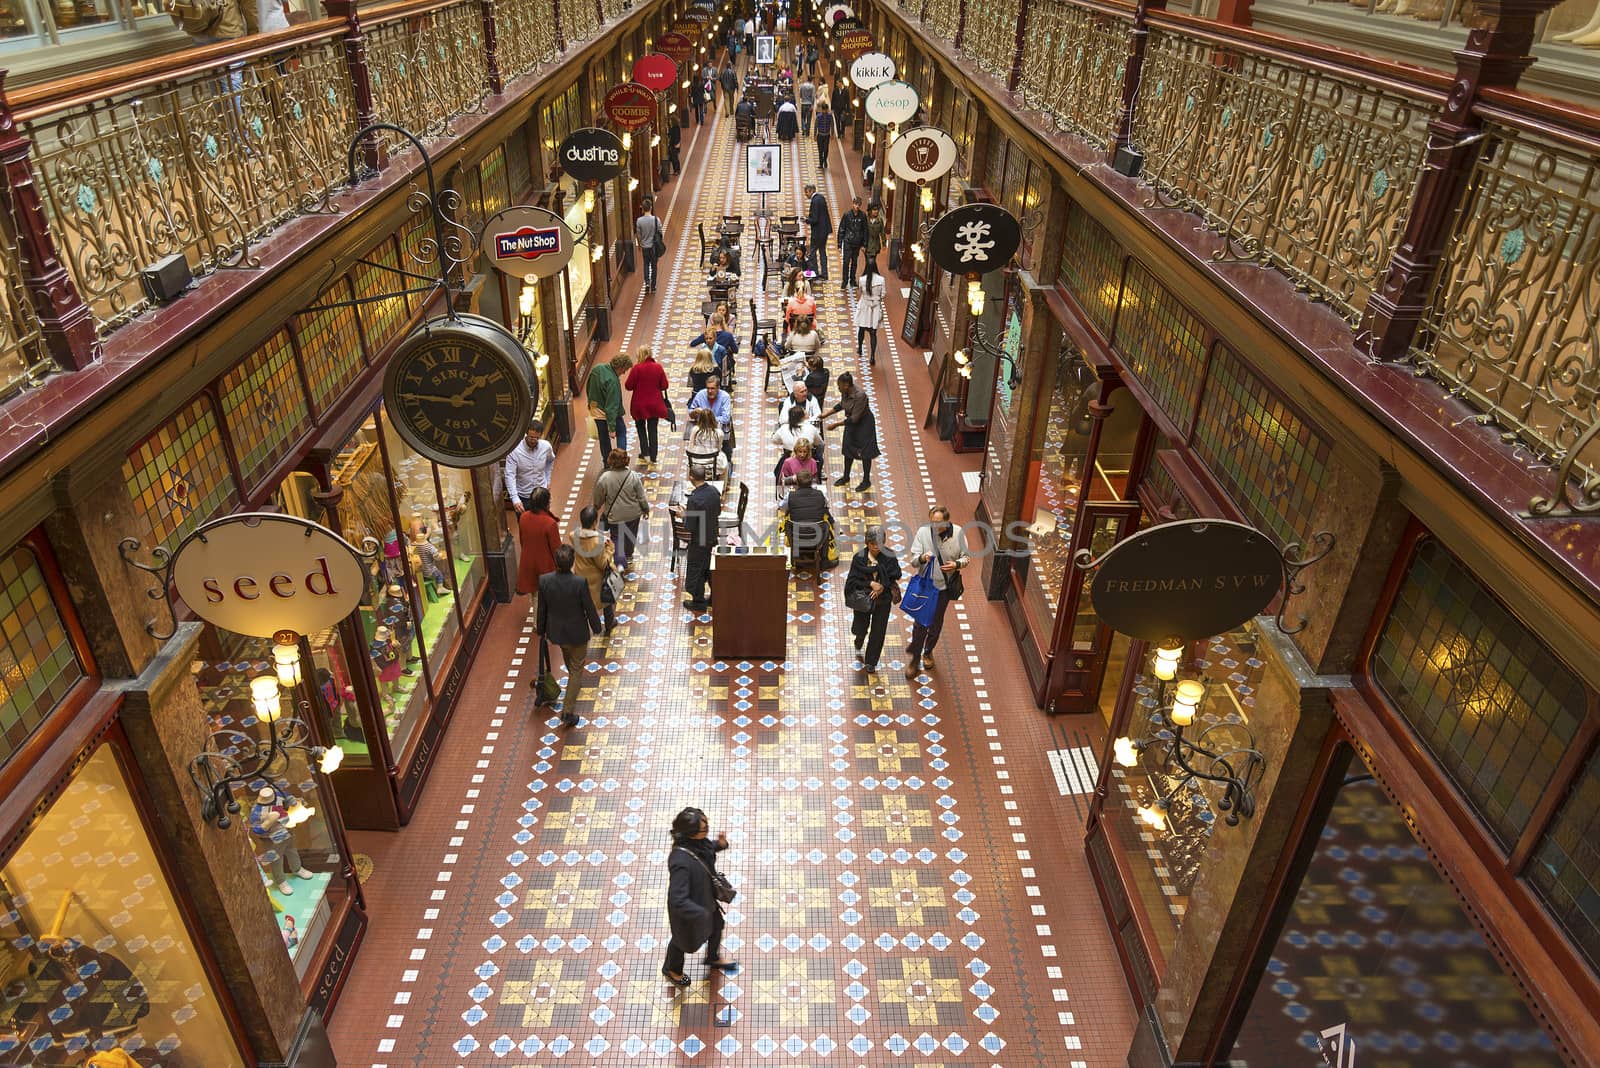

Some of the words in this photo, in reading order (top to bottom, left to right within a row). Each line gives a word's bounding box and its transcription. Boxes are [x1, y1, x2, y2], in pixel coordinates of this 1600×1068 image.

[841, 41, 873, 50] SHOPPING
[856, 66, 890, 78] kikki.K
[612, 108, 650, 116] COOMBS
[876, 97, 910, 111] Aesop
[566, 145, 619, 162] dustins
[500, 239, 517, 252] The
[518, 238, 533, 249] Nut
[533, 235, 556, 248] Shop
[419, 352, 438, 370] XI
[440, 347, 461, 363] XII
[496, 393, 512, 406] III
[444, 419, 478, 430] 1891
[455, 435, 473, 450] VI
[202, 556, 339, 603] seed
[1104, 577, 1203, 593] FREDMAN
[472, 606, 487, 634] seed
[280, 634, 294, 643] 27
[445, 666, 461, 698] seed
[412, 742, 430, 779] seed
[319, 943, 345, 1000] seed
